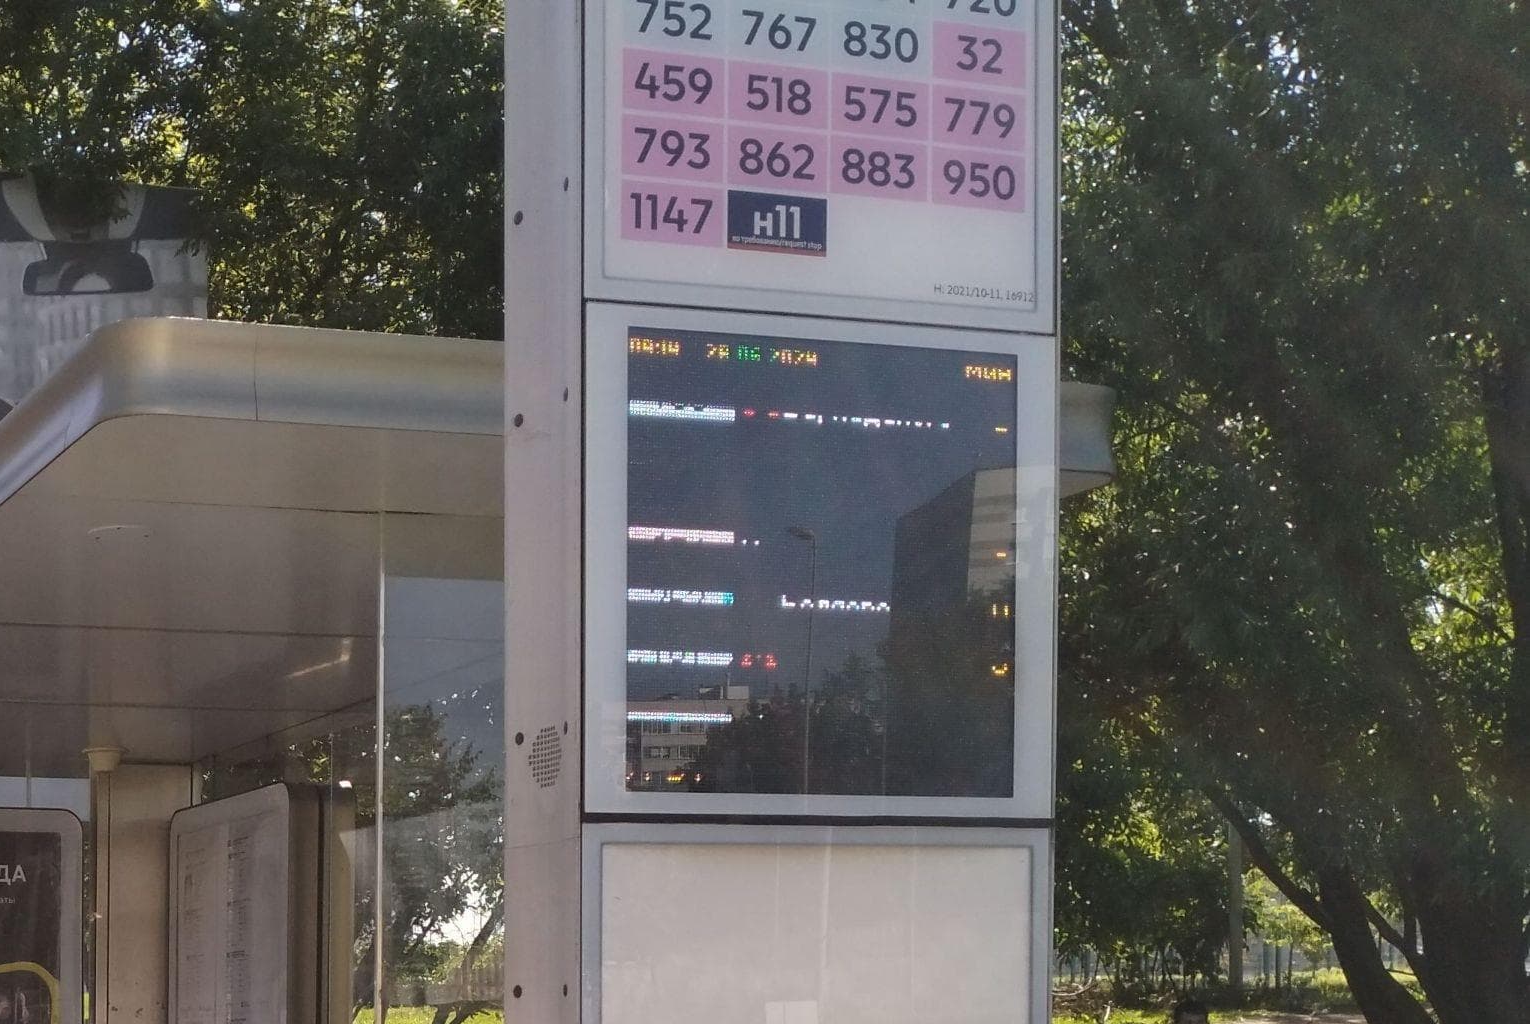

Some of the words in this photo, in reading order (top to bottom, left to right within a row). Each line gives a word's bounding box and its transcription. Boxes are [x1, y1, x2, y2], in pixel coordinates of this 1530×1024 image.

[636, 0, 713, 39] 752
[742, 10, 817, 52] 767
[843, 21, 919, 63] 830
[956, 35, 1003, 74] 32
[634, 62, 713, 104] 459
[746, 74, 811, 115] 518
[844, 85, 917, 127] 575
[944, 97, 1015, 139] 779
[634, 127, 710, 169] 793
[739, 138, 816, 180] 862
[841, 149, 915, 189] 883
[943, 159, 1015, 200] 950
[630, 192, 713, 234] 1147
